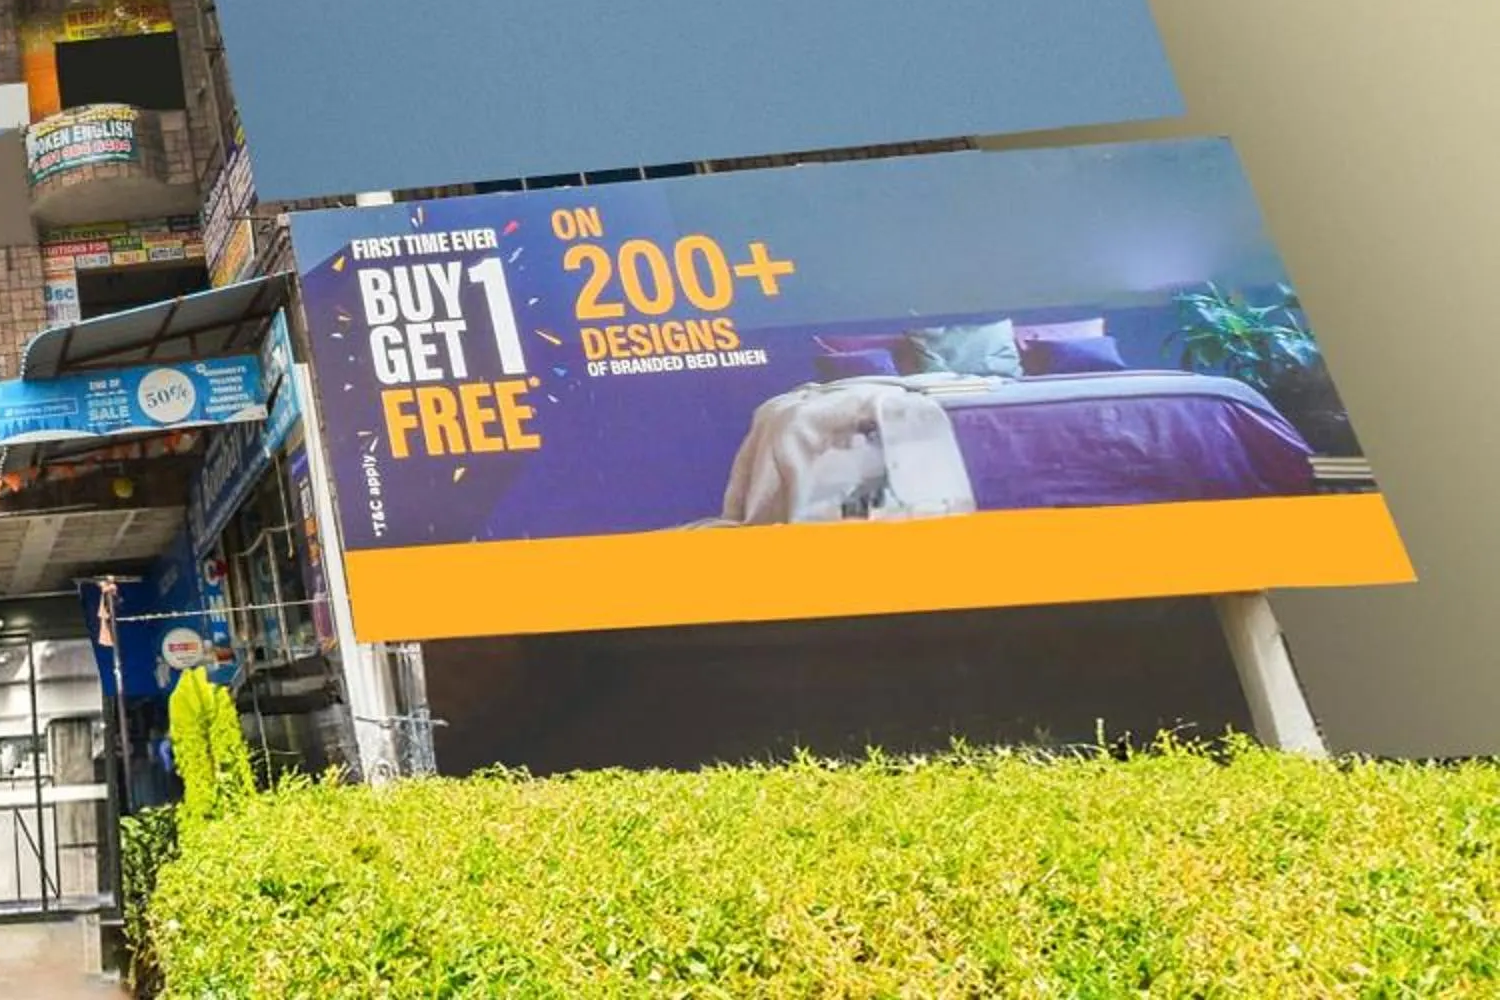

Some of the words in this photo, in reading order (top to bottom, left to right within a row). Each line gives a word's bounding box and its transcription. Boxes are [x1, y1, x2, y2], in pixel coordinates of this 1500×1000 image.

[551, 207, 603, 240] ON
[351, 237, 401, 260] FIRST
[404, 233, 449, 256] TIME
[451, 227, 497, 250] EVER
[563, 233, 795, 320] 200+
[357, 260, 463, 326] BUY
[468, 257, 527, 375] 1
[369, 320, 468, 384] GET
[580, 318, 740, 360] DESIGNS
[587, 361, 608, 377] OF
[611, 356, 683, 375] BRANDED
[686, 352, 718, 369] BED
[722, 349, 768, 367] LINEN
[89, 406, 130, 421] SALE
[145, 383, 189, 409] 50%
[362, 455, 383, 494] apply
